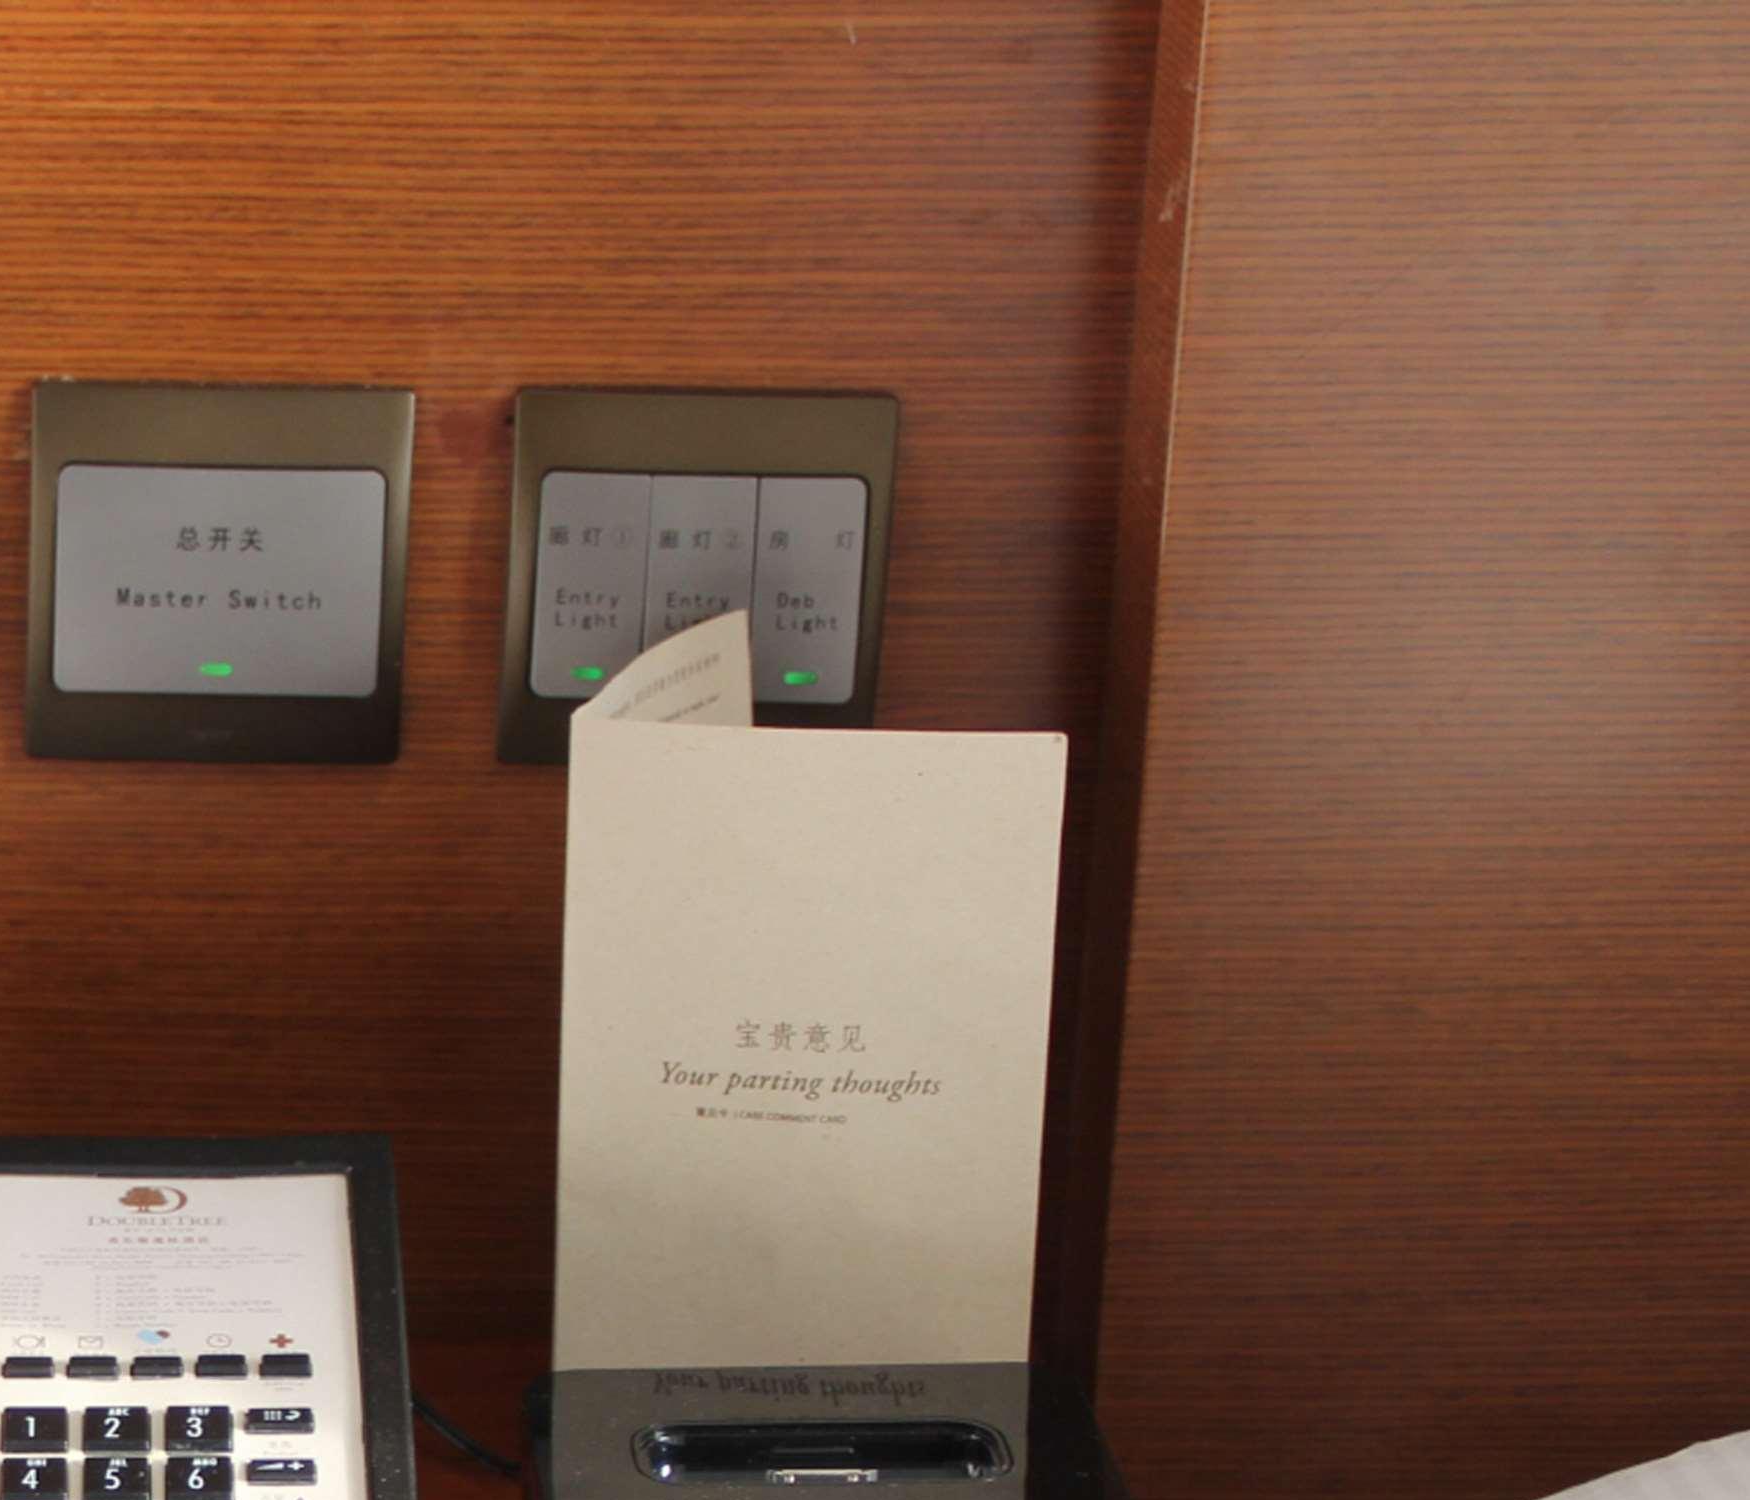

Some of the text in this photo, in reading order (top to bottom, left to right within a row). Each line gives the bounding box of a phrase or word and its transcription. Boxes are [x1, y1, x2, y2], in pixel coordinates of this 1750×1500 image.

[176, 526, 264, 552] 总开关
[116, 586, 322, 611] Master Switch
[555, 588, 620, 608] Entry
[665, 592, 730, 611] Entry
[553, 611, 618, 630] Light
[775, 613, 838, 634] Light
[735, 1019, 867, 1053] 宝贵意见
[660, 1060, 943, 1101] Your parting thoughts
[108, 1408, 130, 1417] ABC
[25, 1417, 203, 1438] 1 2 3
[21, 1469, 204, 1490] 4 5 6
